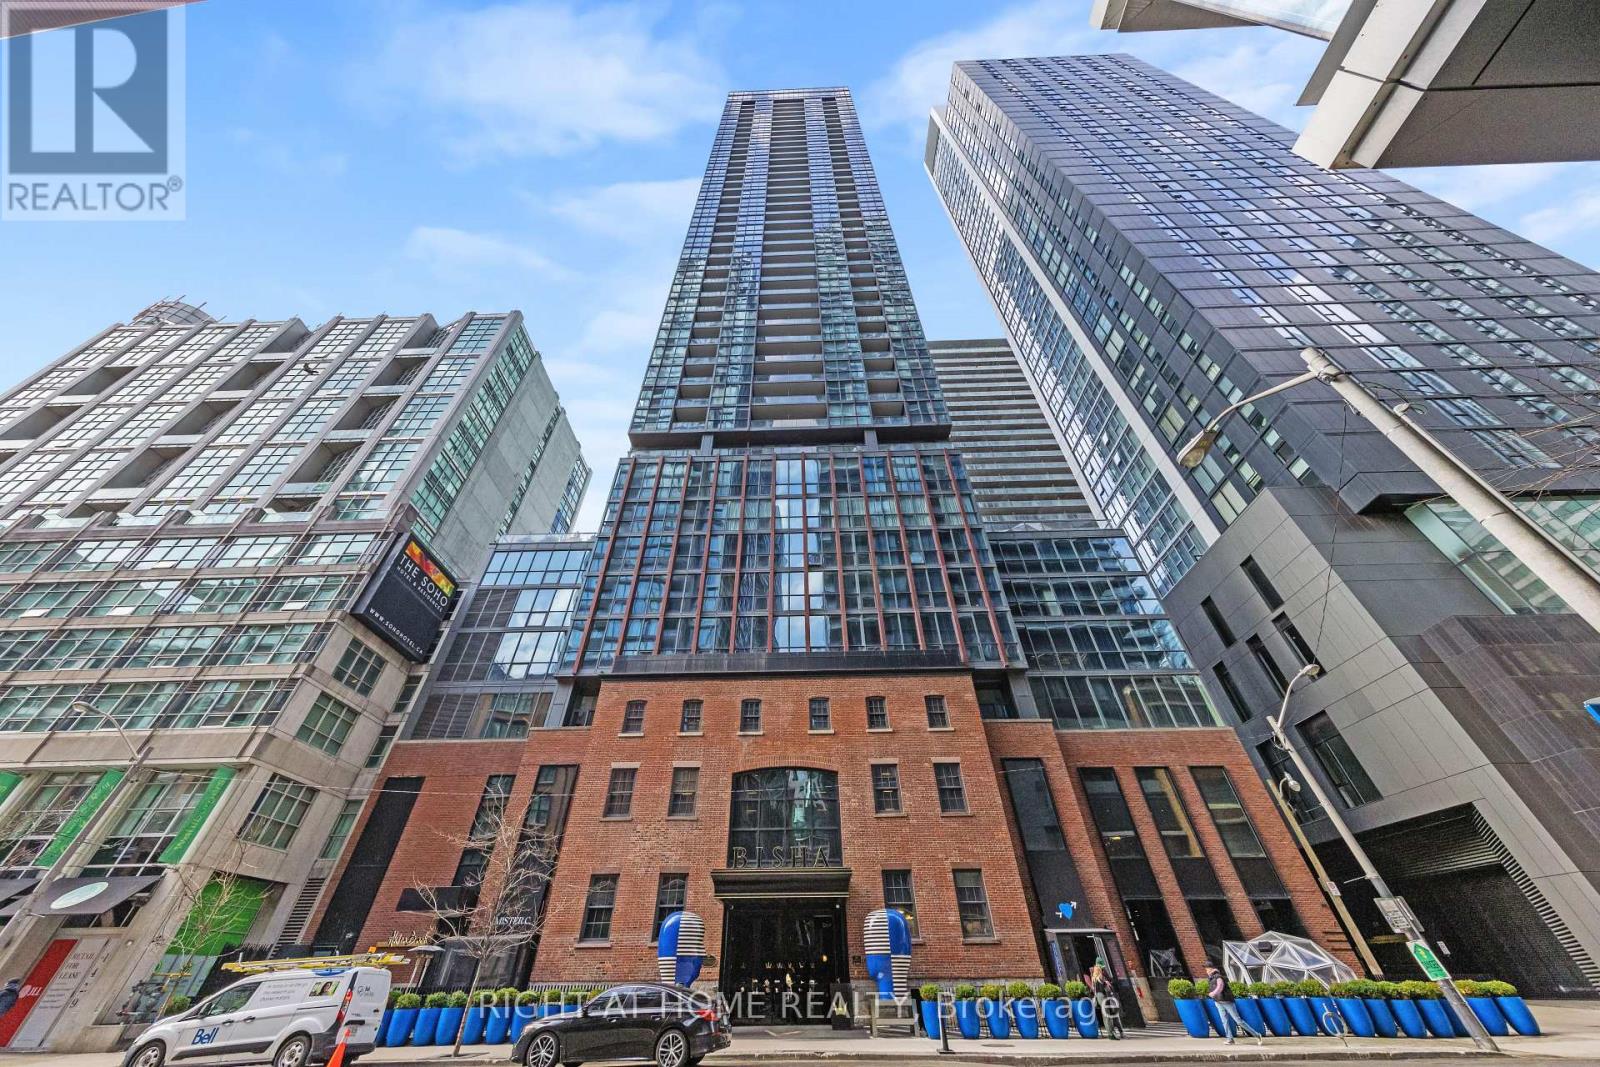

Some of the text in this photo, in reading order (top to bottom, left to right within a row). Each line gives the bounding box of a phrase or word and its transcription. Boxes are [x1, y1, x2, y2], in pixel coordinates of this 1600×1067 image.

[400, 553, 448, 607] THE SOHO
[732, 846, 831, 868] BISHA
[191, 1027, 219, 1045] Bell
